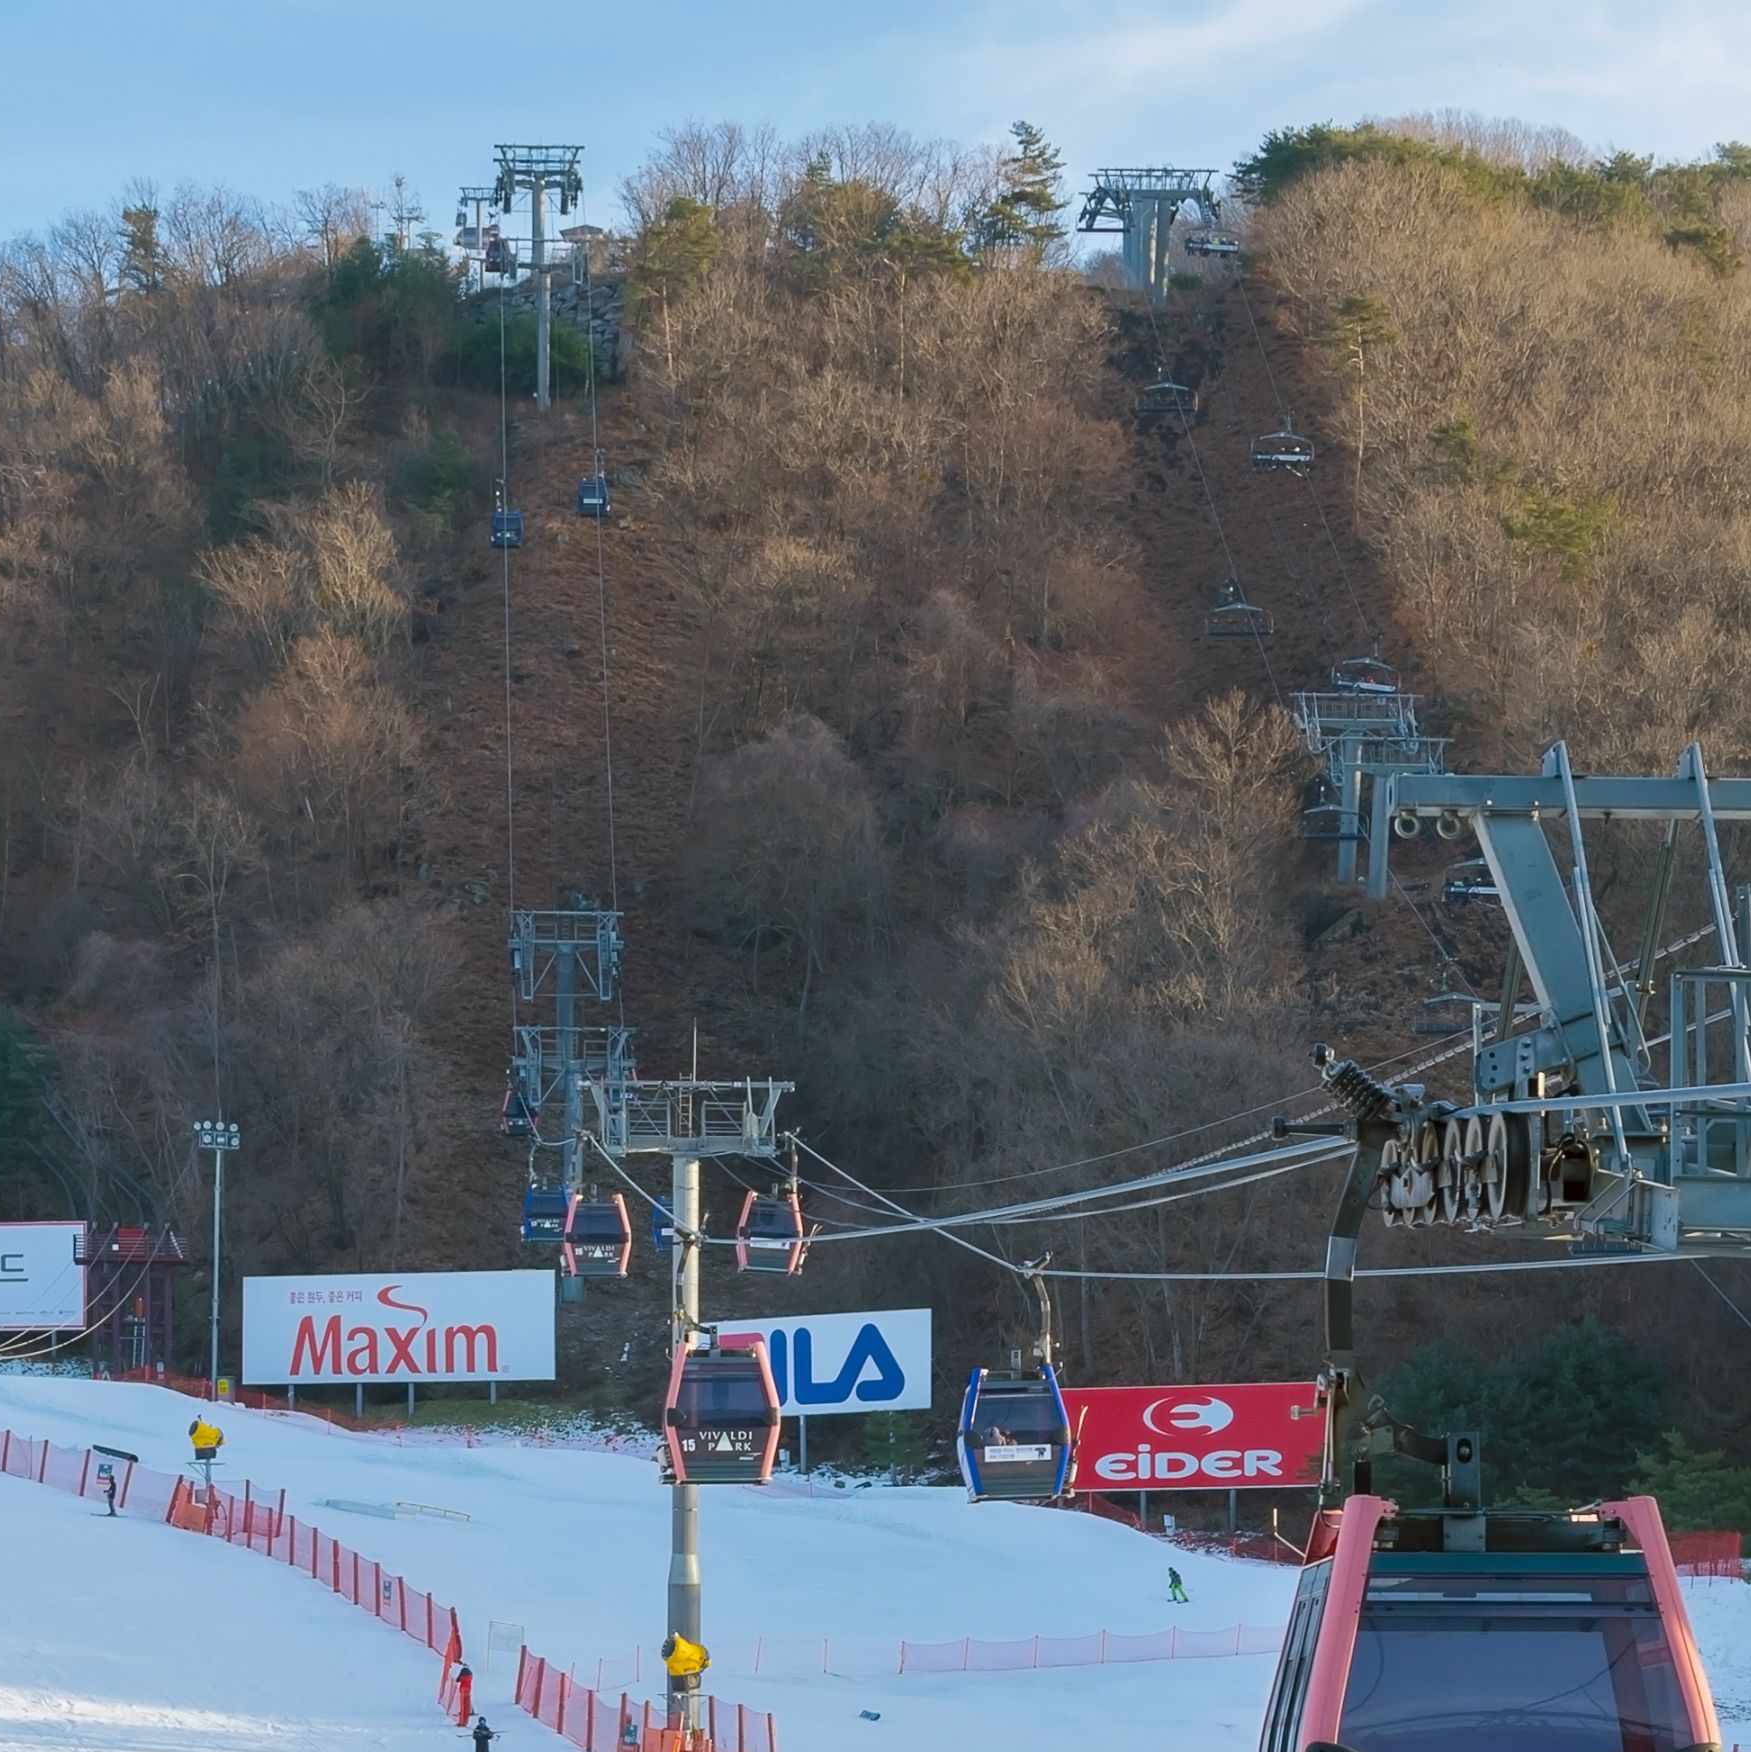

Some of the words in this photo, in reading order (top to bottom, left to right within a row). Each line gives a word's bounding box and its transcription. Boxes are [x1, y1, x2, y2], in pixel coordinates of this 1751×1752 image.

[288, 1291, 305, 1304] 좋은
[328, 1290, 344, 1303] 좋은
[346, 1290, 363, 1302] 커피
[289, 1314, 499, 1376] Maxim
[719, 1323, 905, 1408] ILA
[699, 1431, 753, 1441] VIVALDI
[681, 1439, 696, 1452] 15
[708, 1441, 752, 1452] PARK
